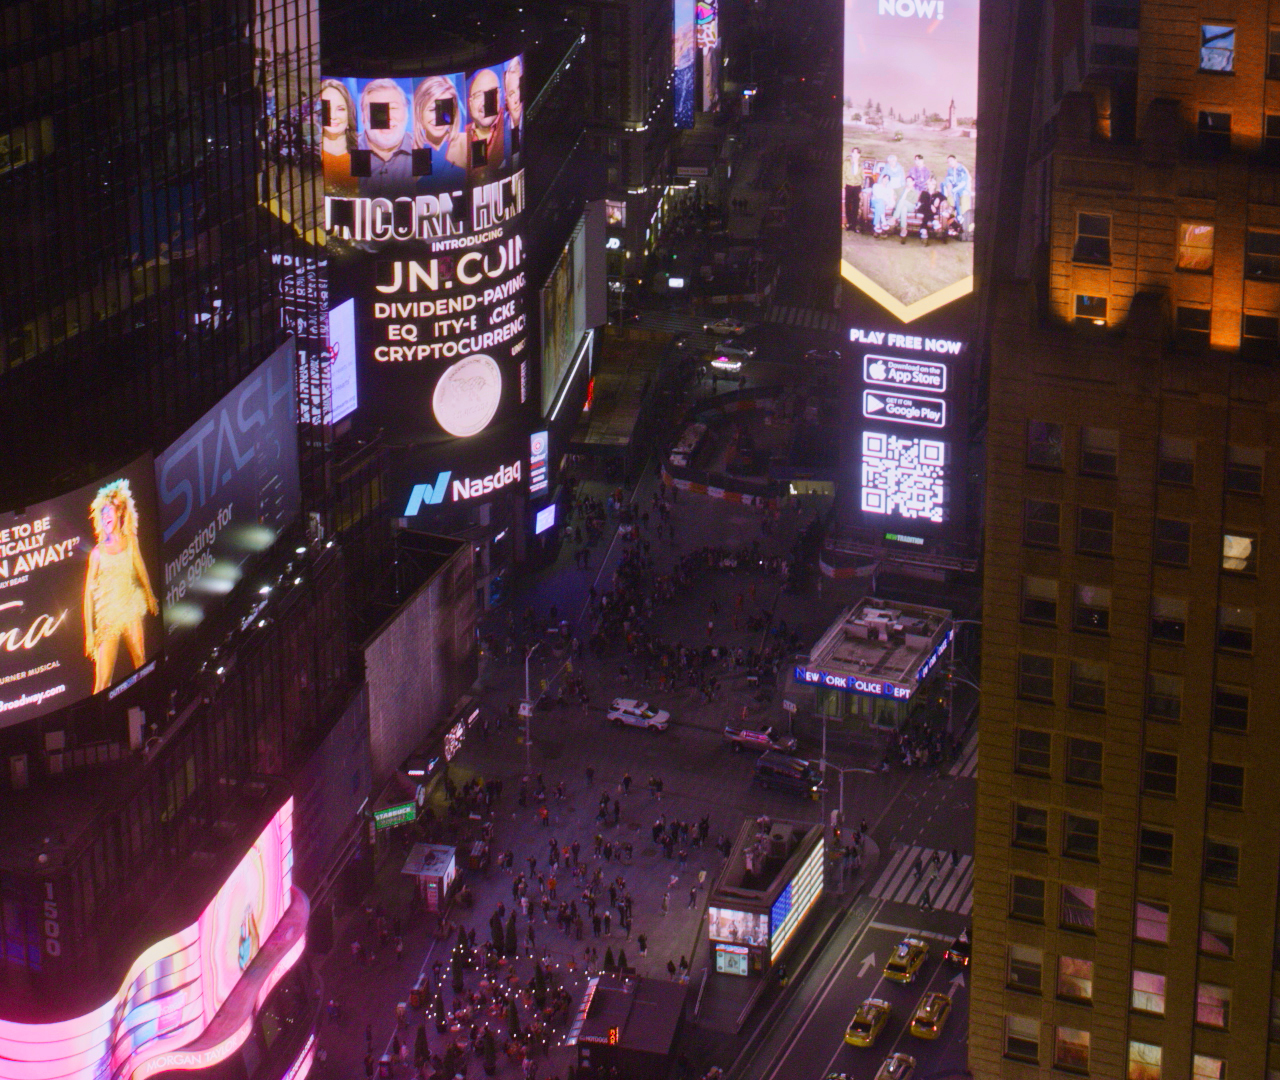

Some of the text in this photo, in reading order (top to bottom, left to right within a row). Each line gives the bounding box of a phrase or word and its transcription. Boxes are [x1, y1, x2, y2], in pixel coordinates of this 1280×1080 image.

[431, 227, 504, 253] INTRODUCING
[849, 328, 961, 355] PLAY FREE NOW
[887, 361, 941, 375] Download on the
[887, 368, 941, 386] App Store
[886, 397, 898, 405] GET
[903, 399, 913, 407] ON
[886, 404, 941, 423] Google Play
[160, 345, 295, 543] STASH
[452, 460, 521, 502] Nasdaq
[11, 523, 32, 540] TO
[33, 517, 51, 534] BE
[164, 521, 216, 585] Investing
[217, 502, 234, 528] for
[10, 575, 29, 588] BEAST
[166, 578, 187, 610] the
[27, 660, 60, 679] MUSICAL
[794, 667, 911, 699] NEW YORK POLICE DEPT
[43, 881, 61, 957] 1500
[145, 1036, 238, 1072] MORGAN TAYLOR
